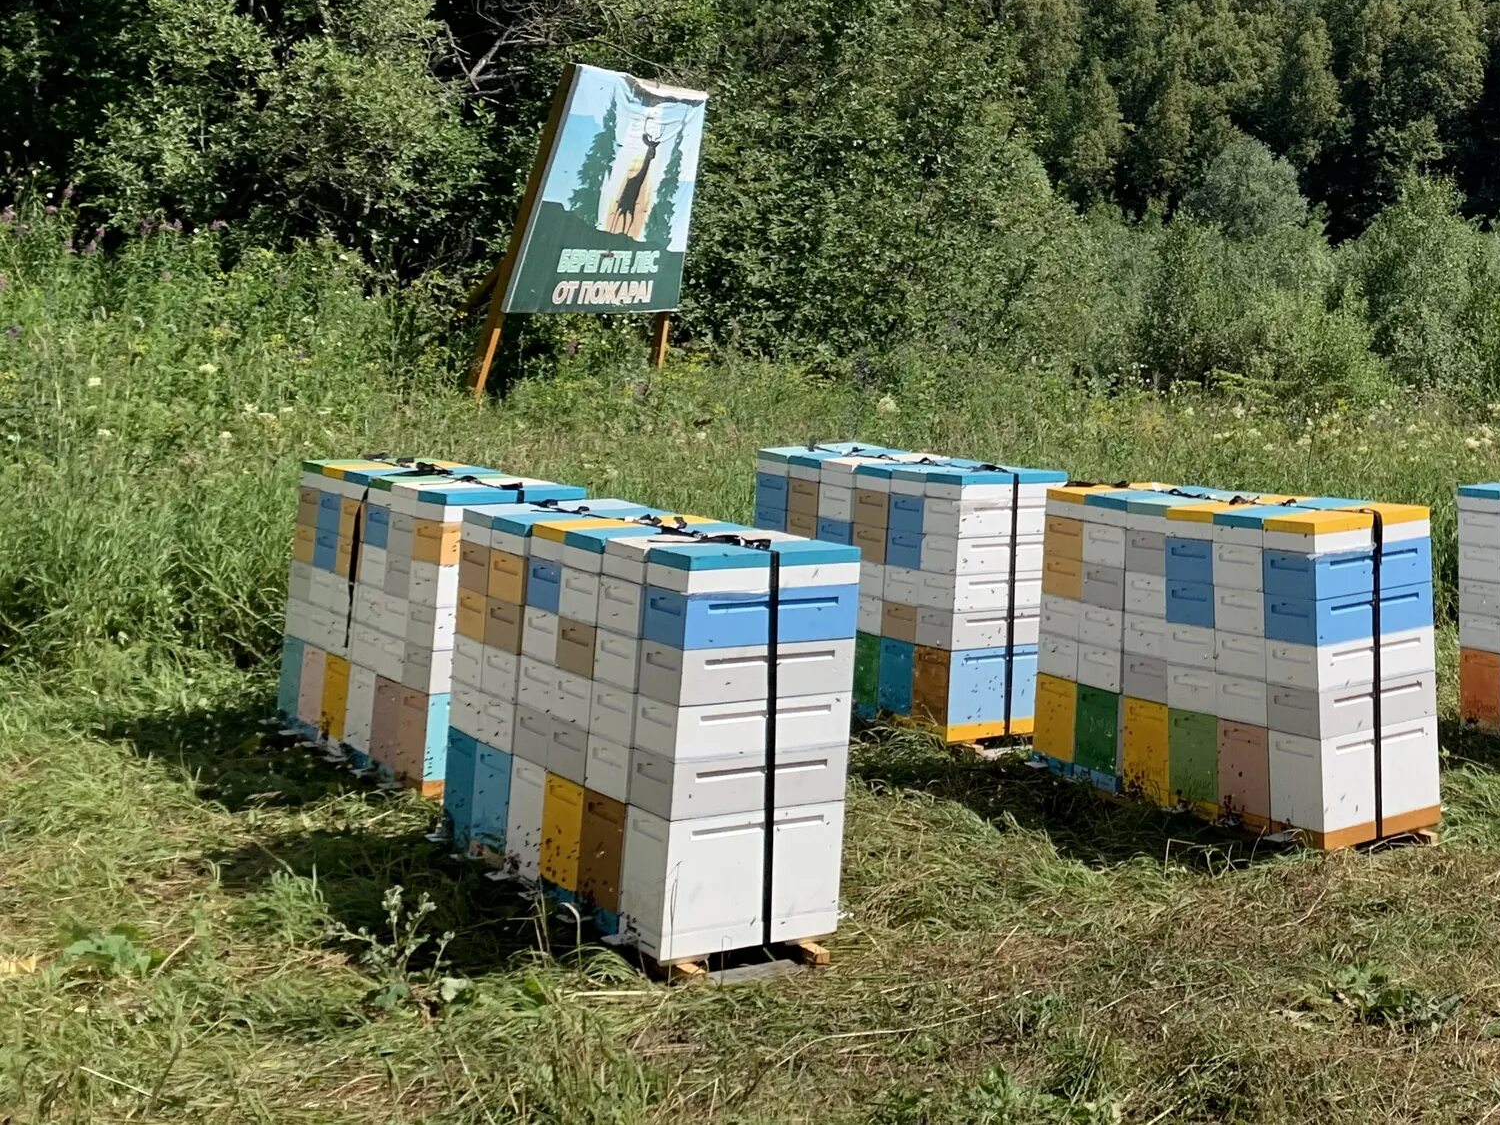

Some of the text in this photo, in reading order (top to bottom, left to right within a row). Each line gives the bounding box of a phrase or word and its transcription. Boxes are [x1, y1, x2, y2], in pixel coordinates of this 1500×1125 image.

[556, 249, 660, 274] БЕРЕГИТЕ ЛЕС
[552, 280, 580, 305] ОТ
